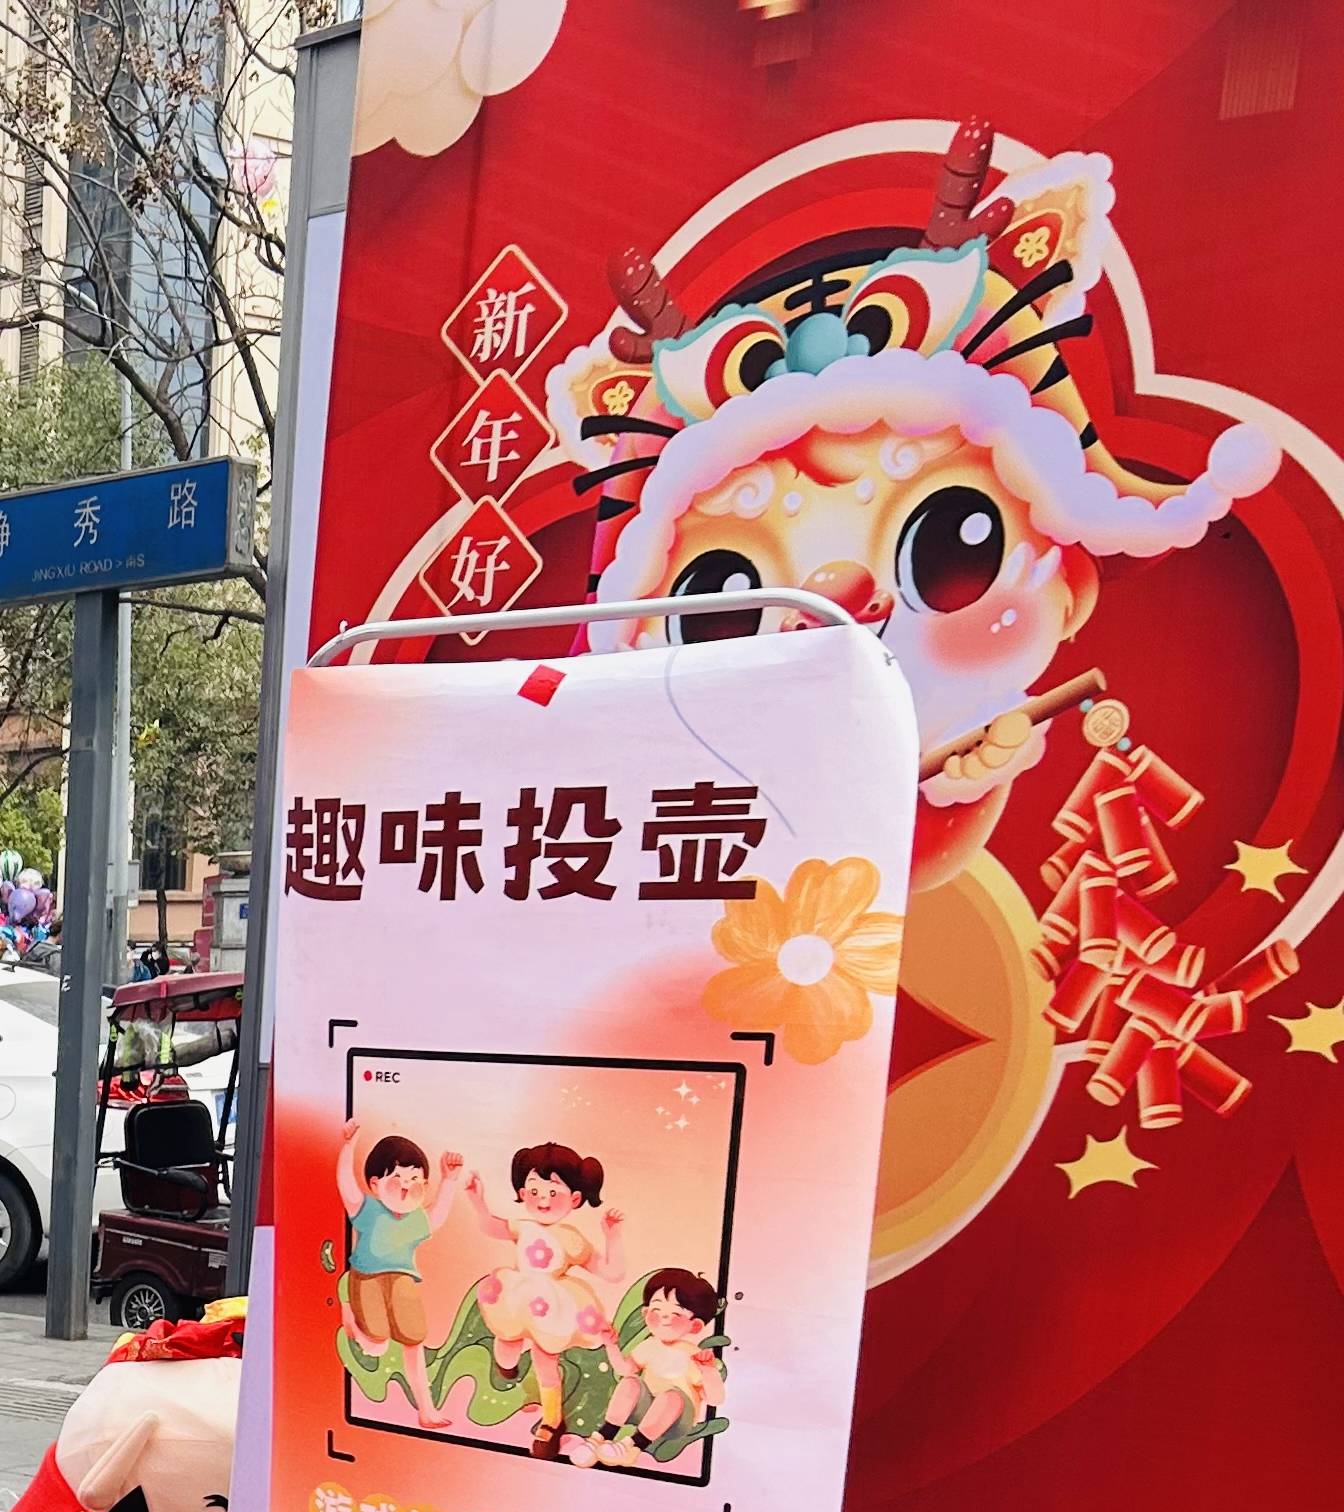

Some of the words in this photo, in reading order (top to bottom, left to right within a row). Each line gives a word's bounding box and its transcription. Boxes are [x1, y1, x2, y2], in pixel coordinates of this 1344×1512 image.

[446, 280, 537, 609] 新年好
[31, 563, 76, 582] JINGXIU
[80, 558, 113, 576] ROAD
[284, 780, 768, 901] 趣味投壶
[375, 1070, 401, 1084] REC
